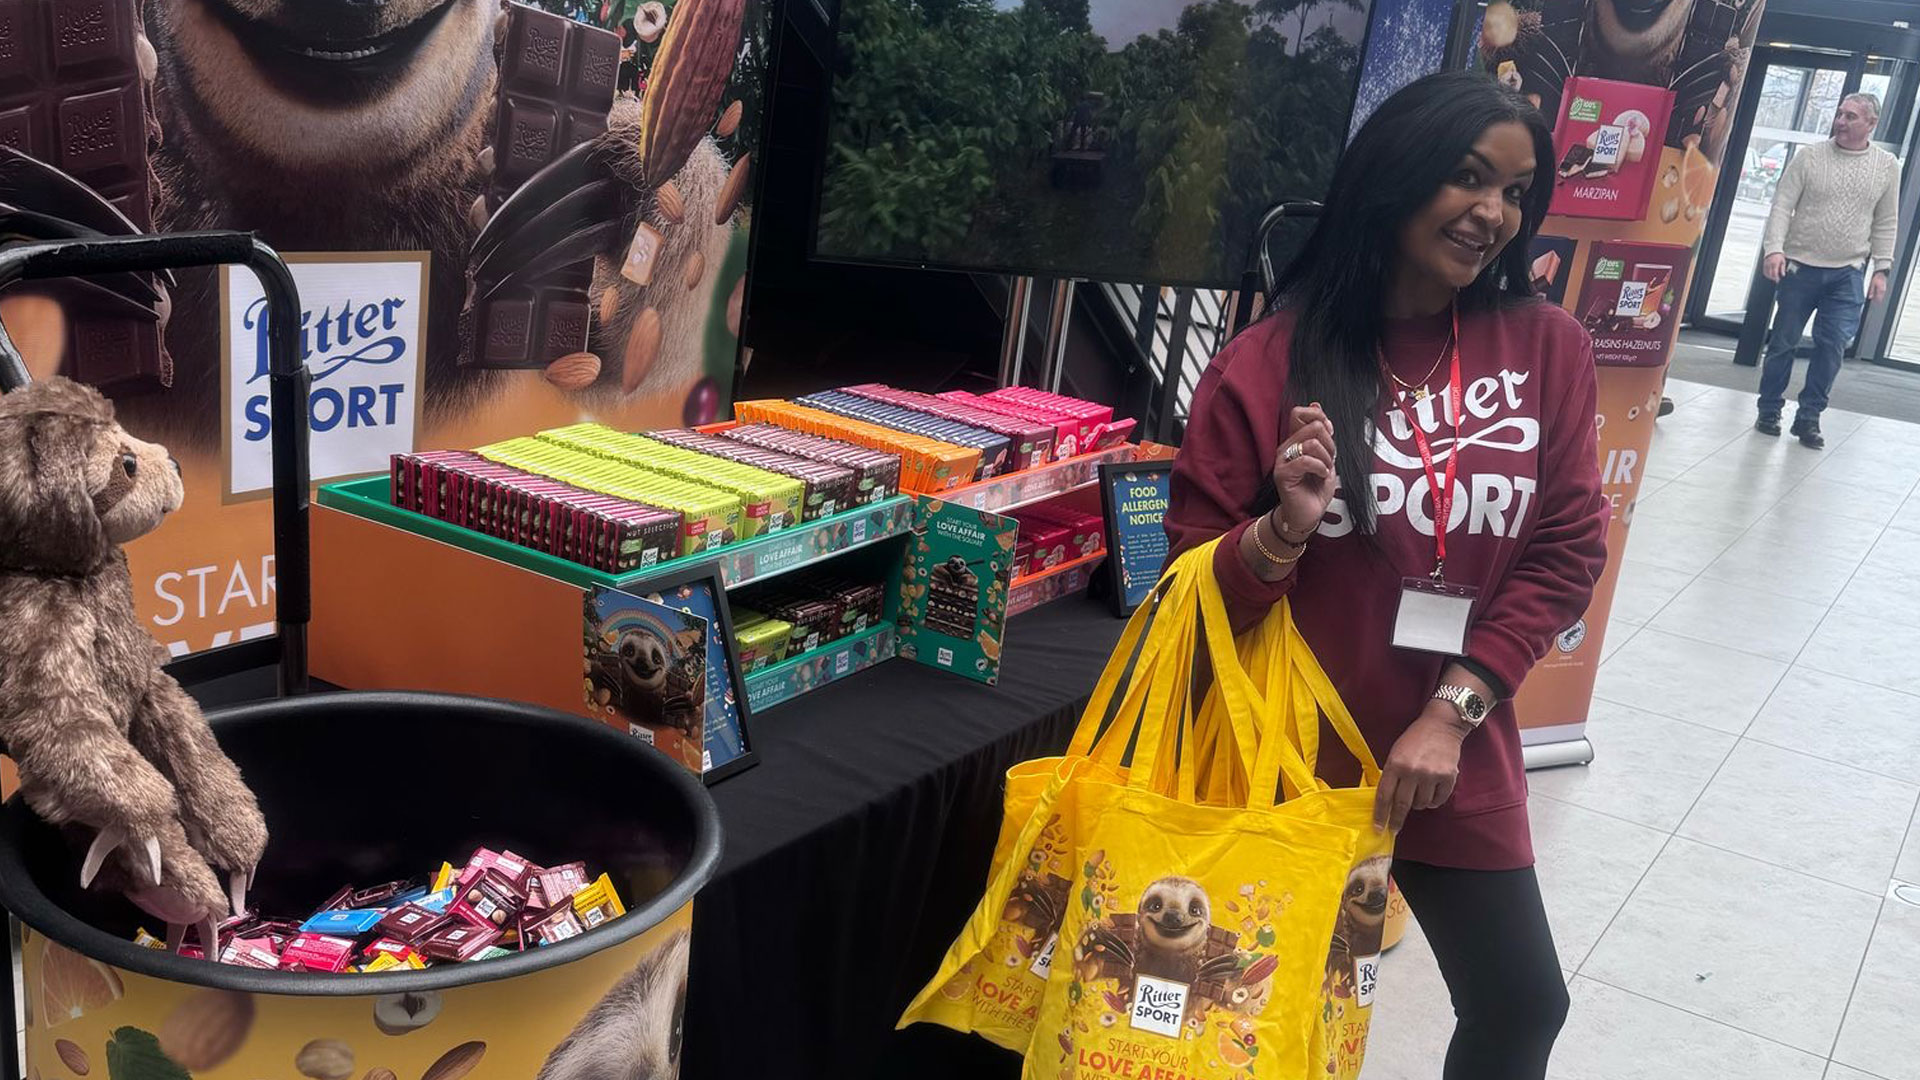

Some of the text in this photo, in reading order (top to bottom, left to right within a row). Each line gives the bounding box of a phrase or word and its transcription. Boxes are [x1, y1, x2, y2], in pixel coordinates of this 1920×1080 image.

[1596, 146, 1617, 156] SPORT
[1573, 186, 1619, 201] MARZIPAN
[1619, 300, 1642, 310] SPORT
[1594, 338, 1662, 351] RAISINS HAZELNUTS
[244, 383, 405, 442] SORT
[1365, 367, 1541, 470] itter
[1129, 486, 1158, 499] FOOD
[1121, 499, 1169, 513] ALLERGEN
[1129, 512, 1164, 525] NOTICE
[626, 520, 679, 538] NUT SELECTION
[936, 521, 986, 541] LOVE AFFAIR
[758, 544, 804, 565] LOVE AFFAIR
[152, 554, 277, 626] STAR
[760, 681, 786, 698] AFFAIR
[976, 974, 1022, 1010] LOVE
[1003, 975, 1040, 1002] START
[1140, 984, 1182, 1009] Ritter
[1001, 1012, 1026, 1030] THE
[1136, 1006, 1179, 1025] SPORT
[1343, 1022, 1369, 1037] STA
[1108, 1038, 1189, 1071] START YOUR
[1079, 1048, 1206, 1080] LOVE AFFA
